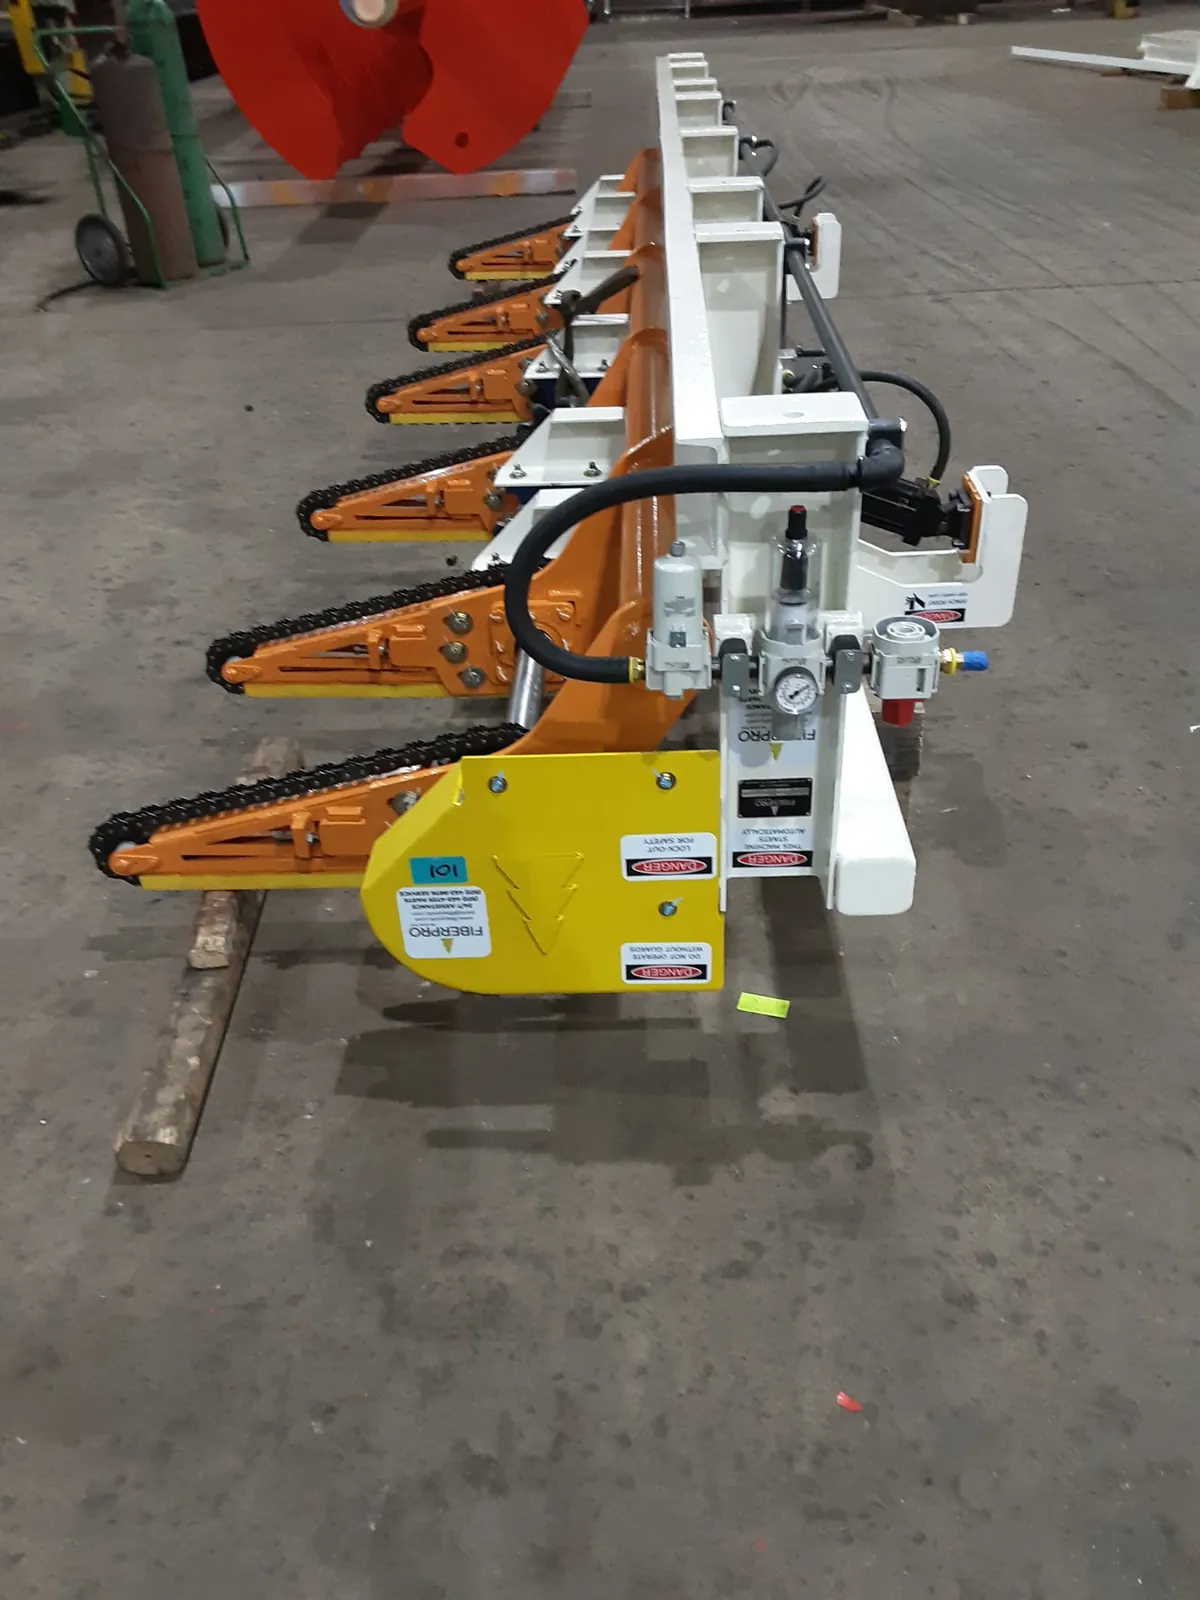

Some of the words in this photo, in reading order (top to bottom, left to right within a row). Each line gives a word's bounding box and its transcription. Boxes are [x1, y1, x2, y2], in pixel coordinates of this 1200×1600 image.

[738, 729, 816, 742] FIPRO
[647, 845, 692, 853] LOCK-OUT
[748, 854, 799, 864] DANGER
[430, 864, 458, 878] 101
[643, 860, 698, 872] DANGER
[409, 926, 484, 938] FIBERPRO
[641, 966, 693, 977] DANGER
